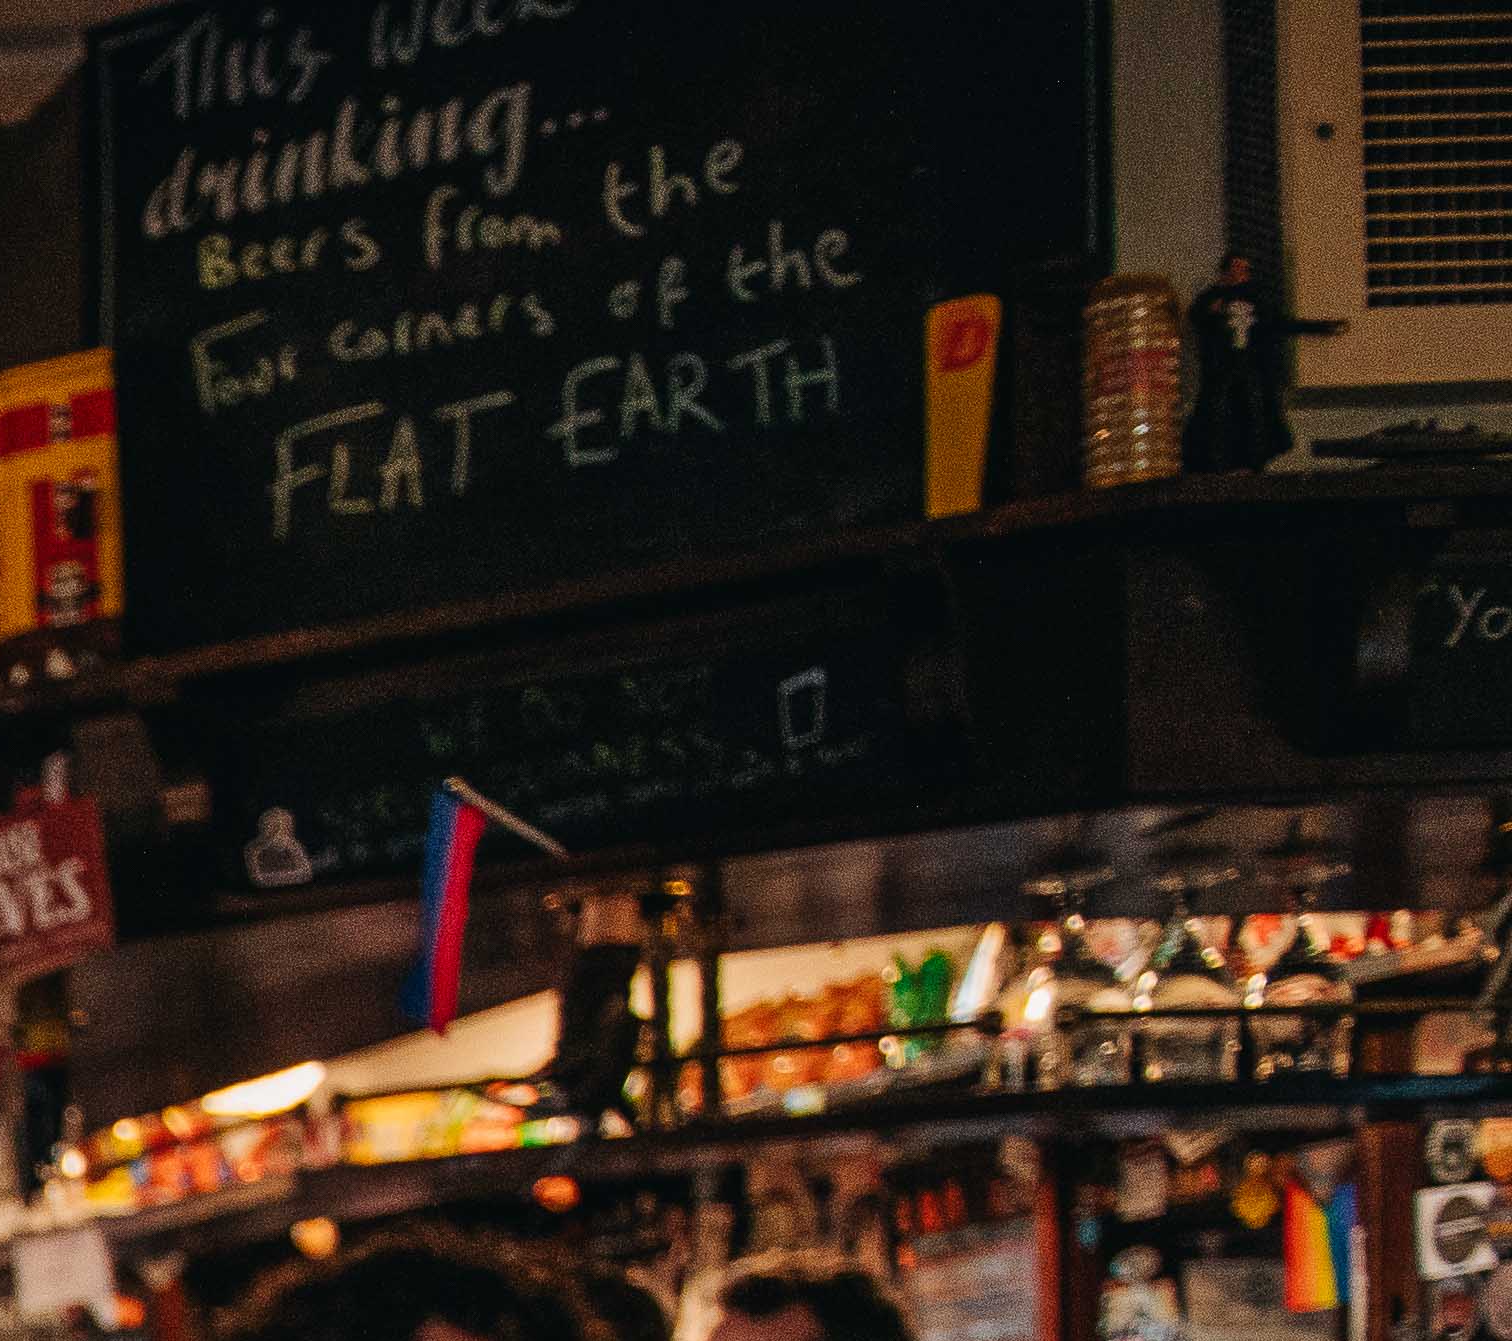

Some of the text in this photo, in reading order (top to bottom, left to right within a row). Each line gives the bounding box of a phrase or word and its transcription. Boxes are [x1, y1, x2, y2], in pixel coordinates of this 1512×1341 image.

[144, 14, 330, 118] This
[197, 139, 743, 289] Beers from the
[188, 220, 862, 413] Four corners of the
[271, 337, 842, 539] FLAT EARTH
